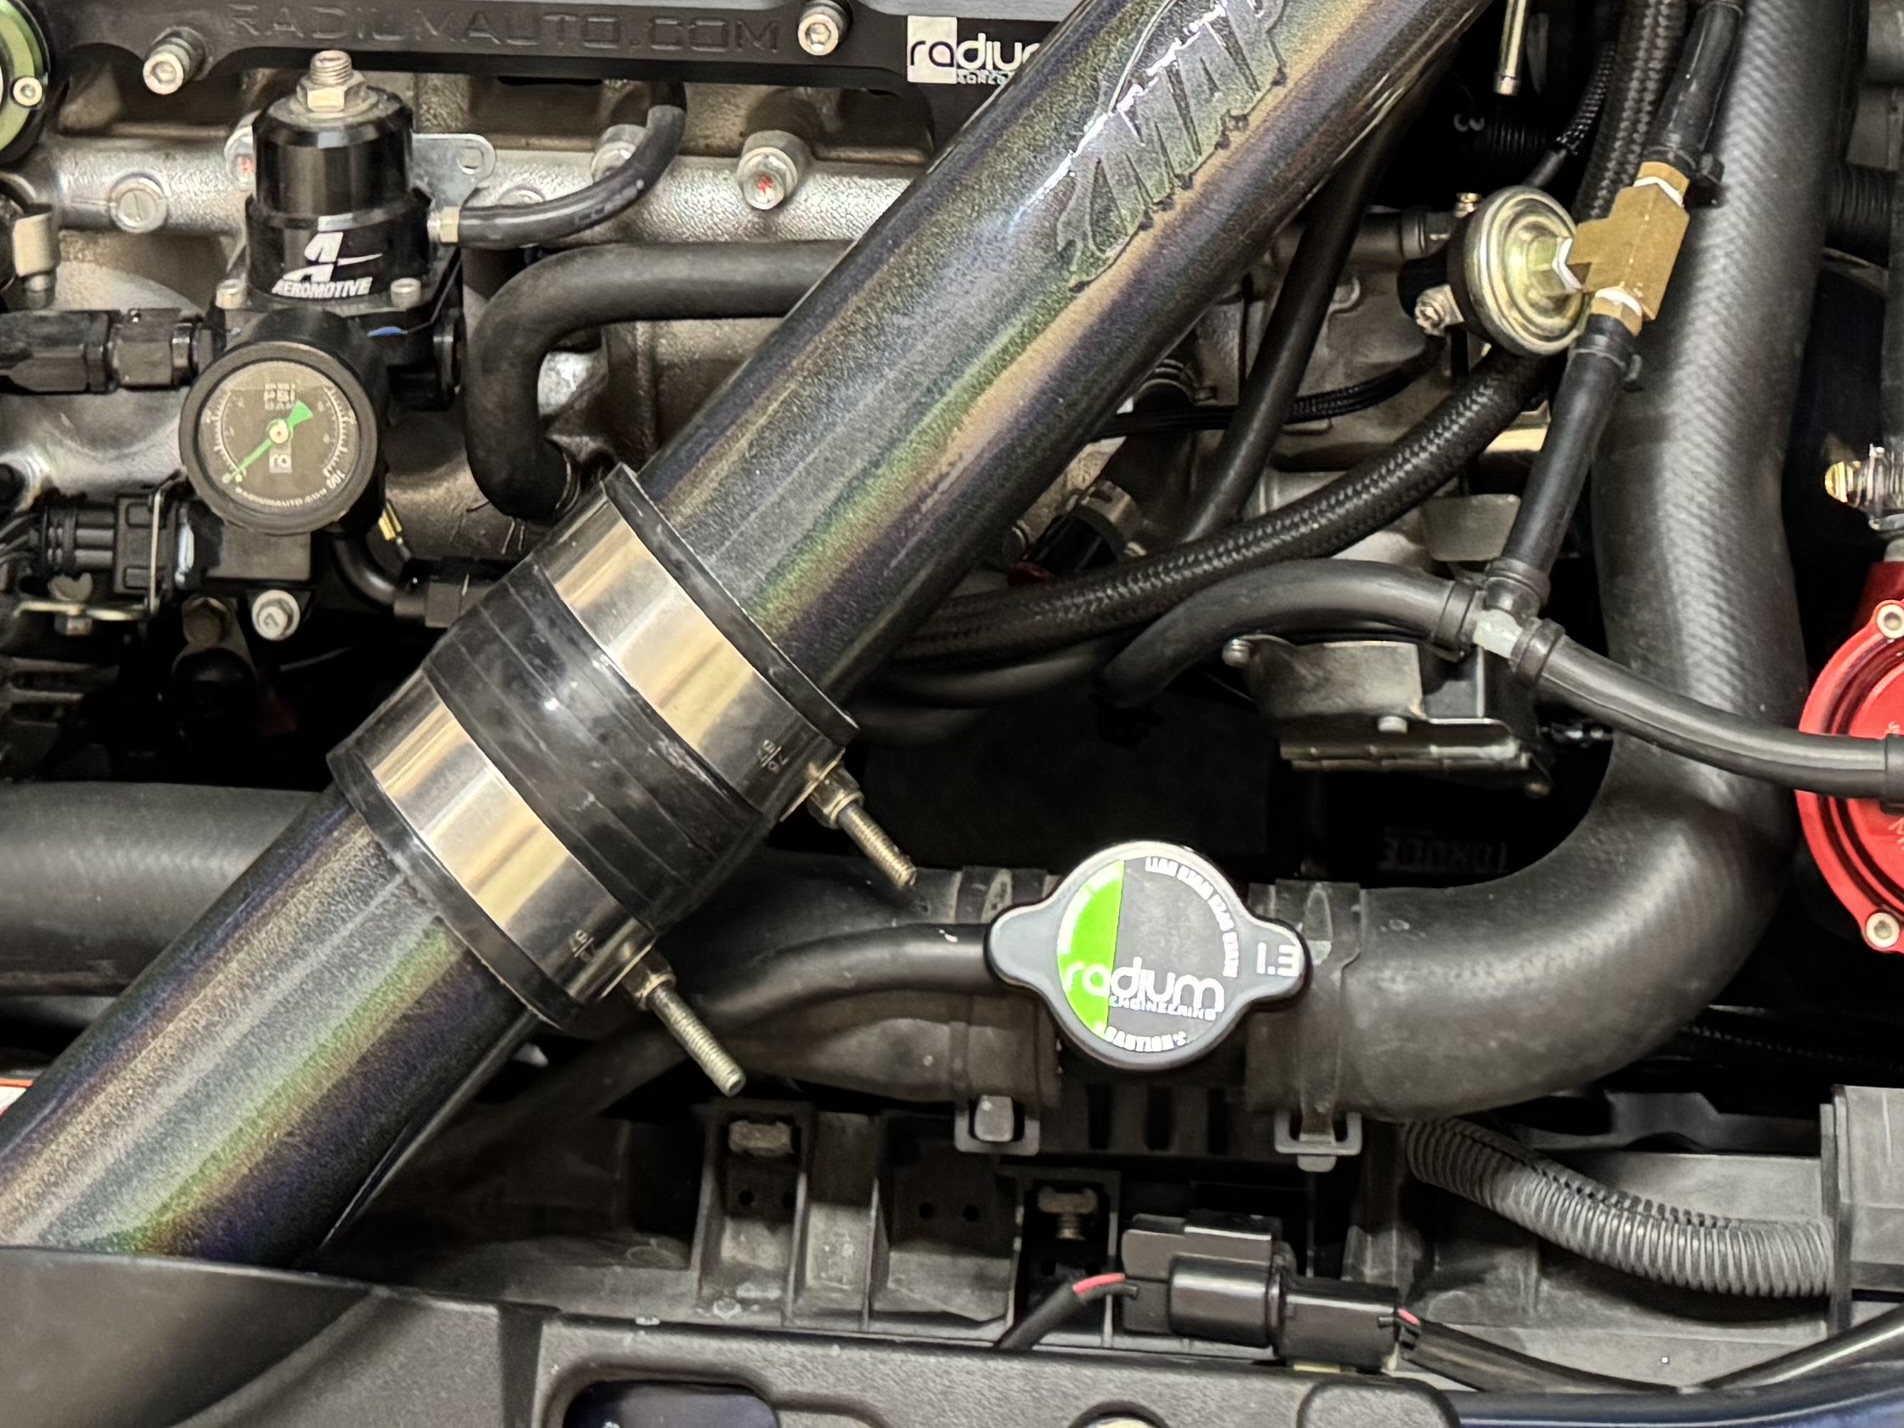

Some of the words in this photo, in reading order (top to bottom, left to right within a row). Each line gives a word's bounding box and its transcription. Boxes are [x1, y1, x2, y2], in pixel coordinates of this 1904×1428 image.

[225, 4, 780, 54] RADIUMAUTO.COM
[271, 277, 374, 299] AEROMOTIVE
[1256, 942, 1299, 978] 1.3
[1064, 956, 1225, 1013] radium
[1108, 995, 1217, 1021] ENGINEERING
